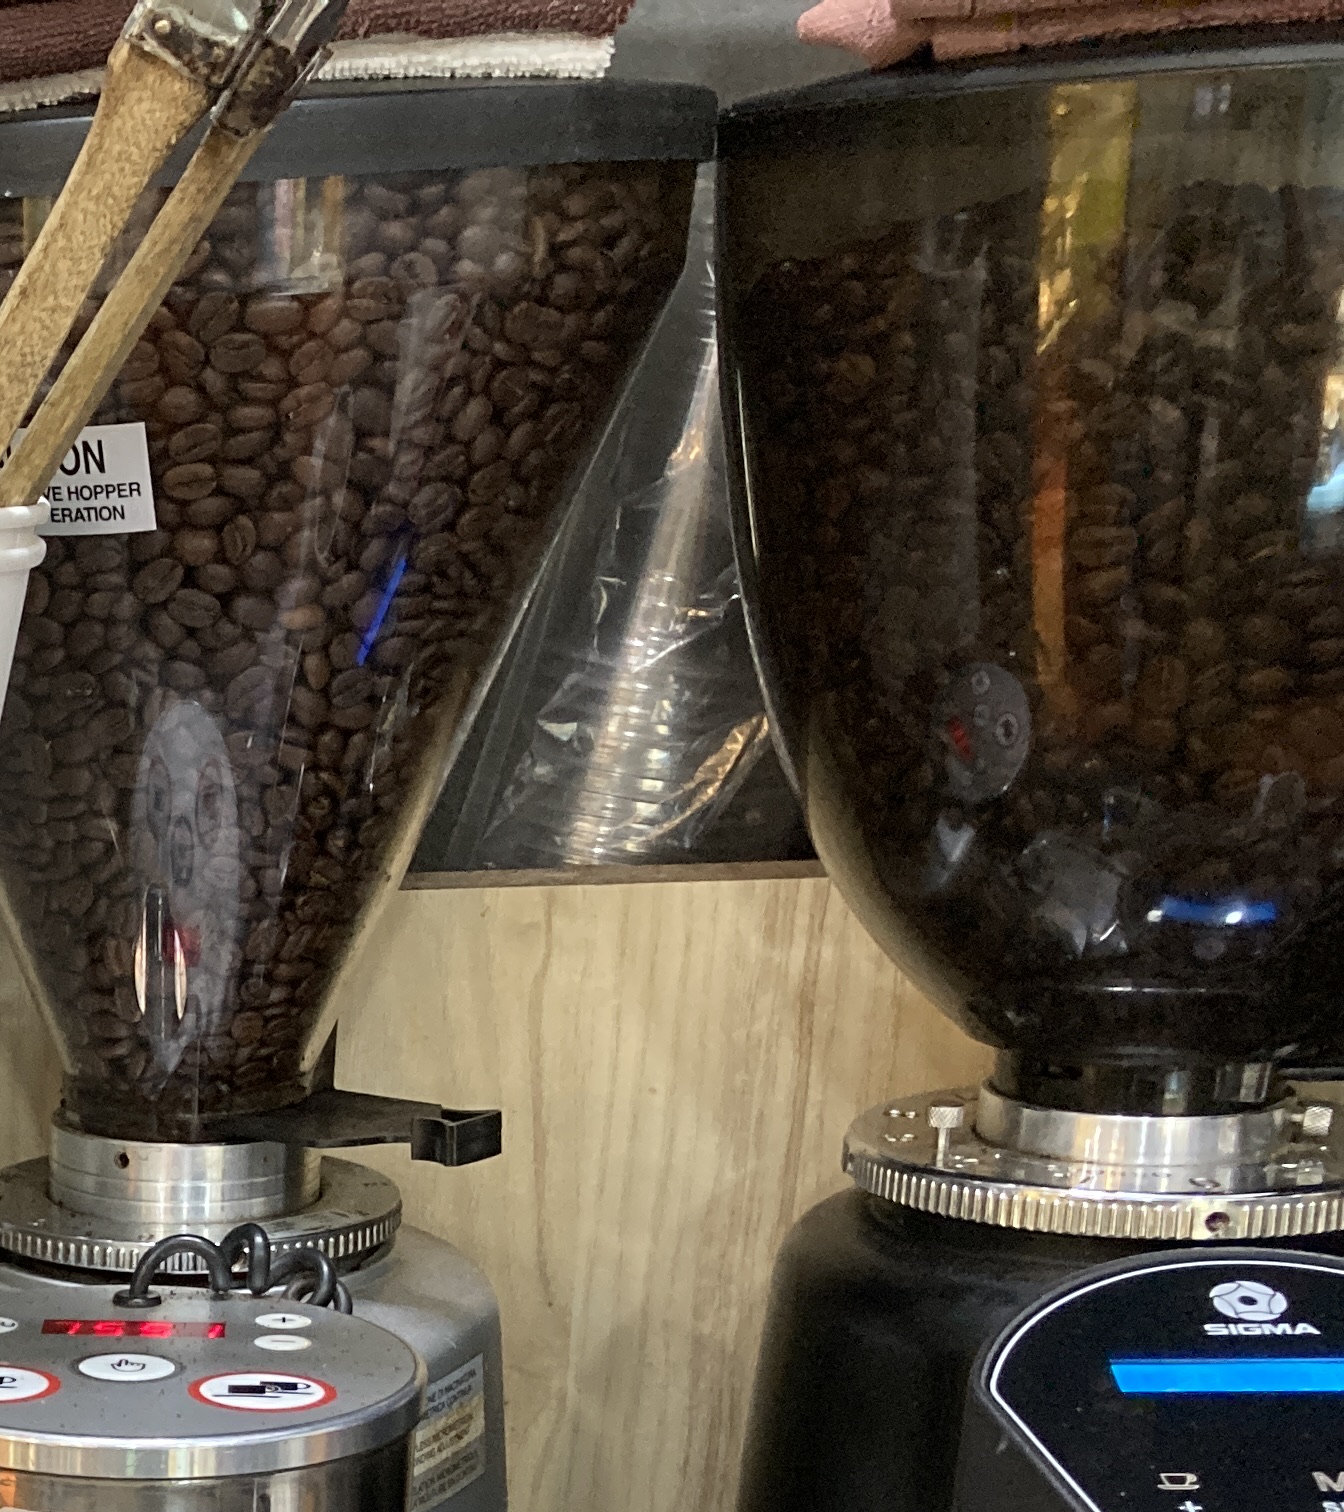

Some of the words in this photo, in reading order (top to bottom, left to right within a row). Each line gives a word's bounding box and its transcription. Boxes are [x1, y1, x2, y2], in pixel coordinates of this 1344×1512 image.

[67, 482, 141, 501] HOPPER
[50, 505, 126, 523] ERATION
[1203, 1323, 1322, 1336] SIGMA
